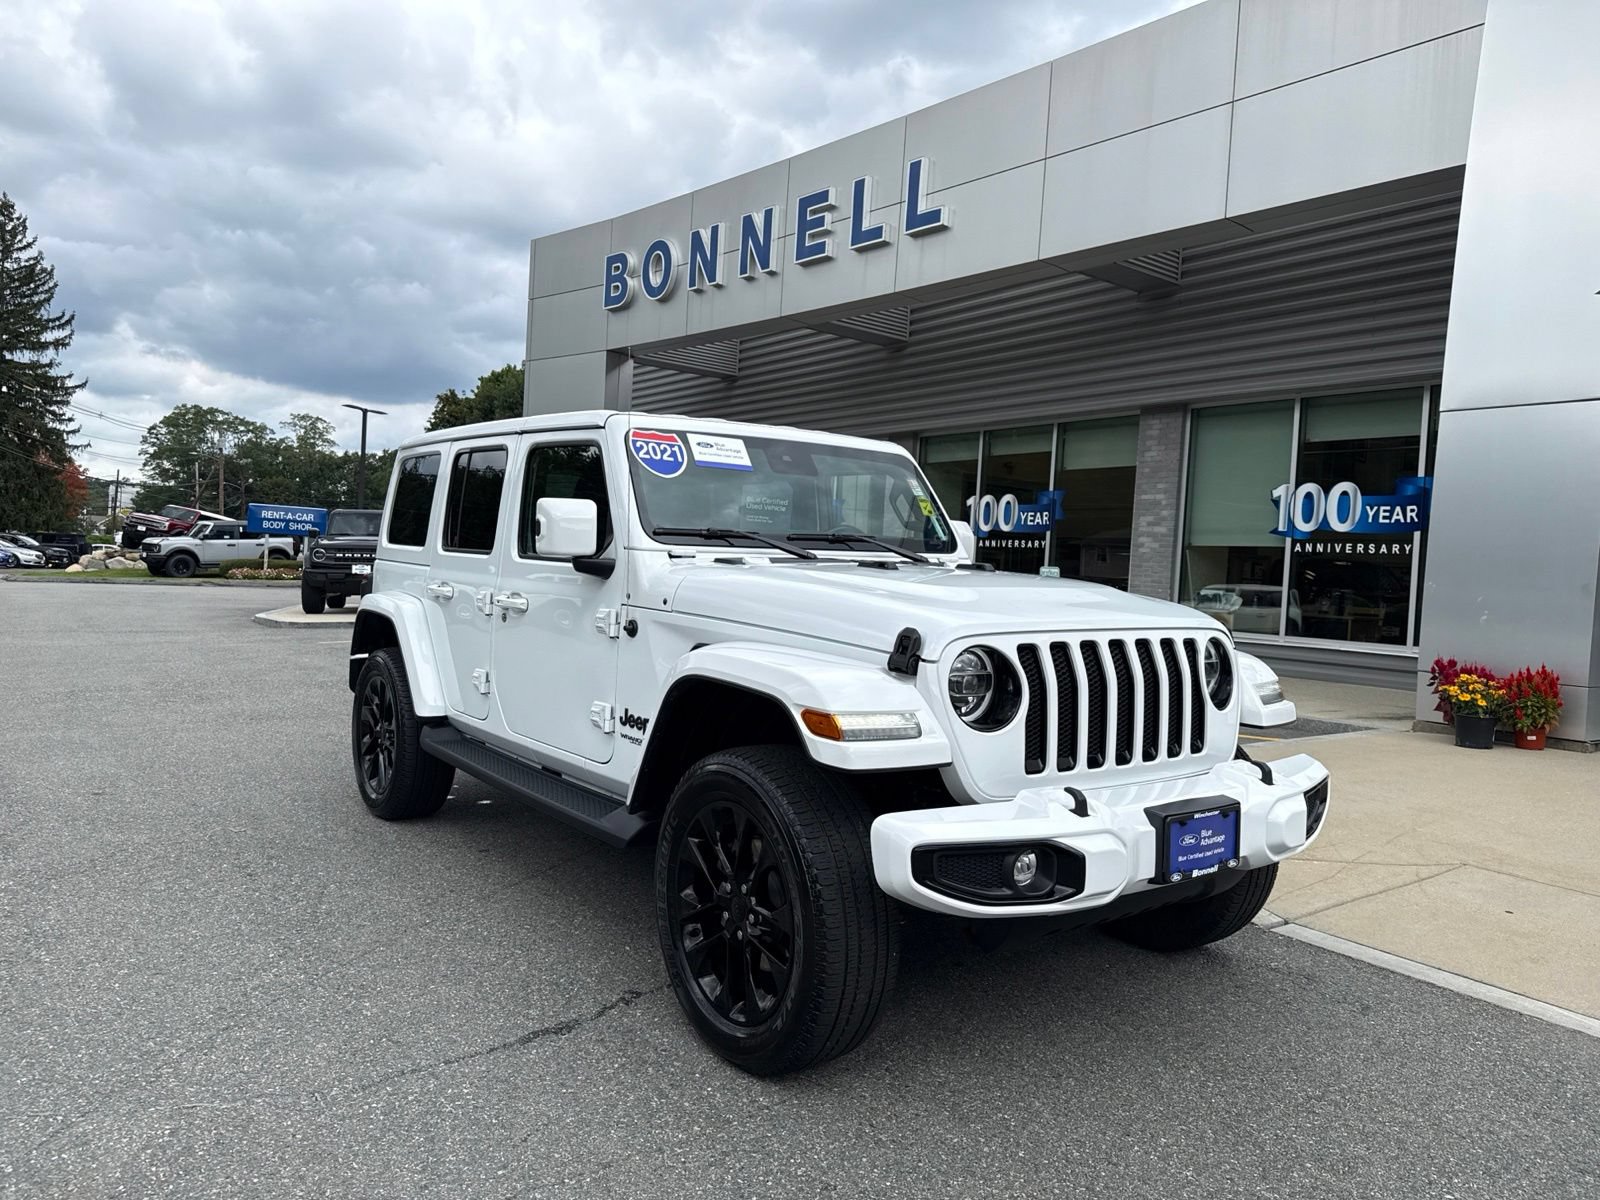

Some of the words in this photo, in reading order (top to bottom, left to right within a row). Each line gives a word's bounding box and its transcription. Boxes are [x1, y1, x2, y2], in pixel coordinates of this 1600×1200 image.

[603, 157, 949, 311] BONNELL
[636, 441, 683, 463] 2021
[966, 493, 1019, 532] 100
[1020, 511, 1050, 525] YEAR
[1272, 481, 1363, 532] 100
[1366, 505, 1419, 524] YEAR
[261, 510, 314, 522] RENT-A-CAR
[262, 521, 286, 530] BODY
[288, 522, 313, 531] SHOP
[978, 539, 1047, 549] ANNIVERSARY
[1294, 543, 1413, 555] ANNIVERSARY
[619, 708, 649, 735] Jeep
[1200, 829, 1212, 837] Blue
[1200, 834, 1225, 846] Advantage
[1192, 864, 1219, 877] Bonnell
